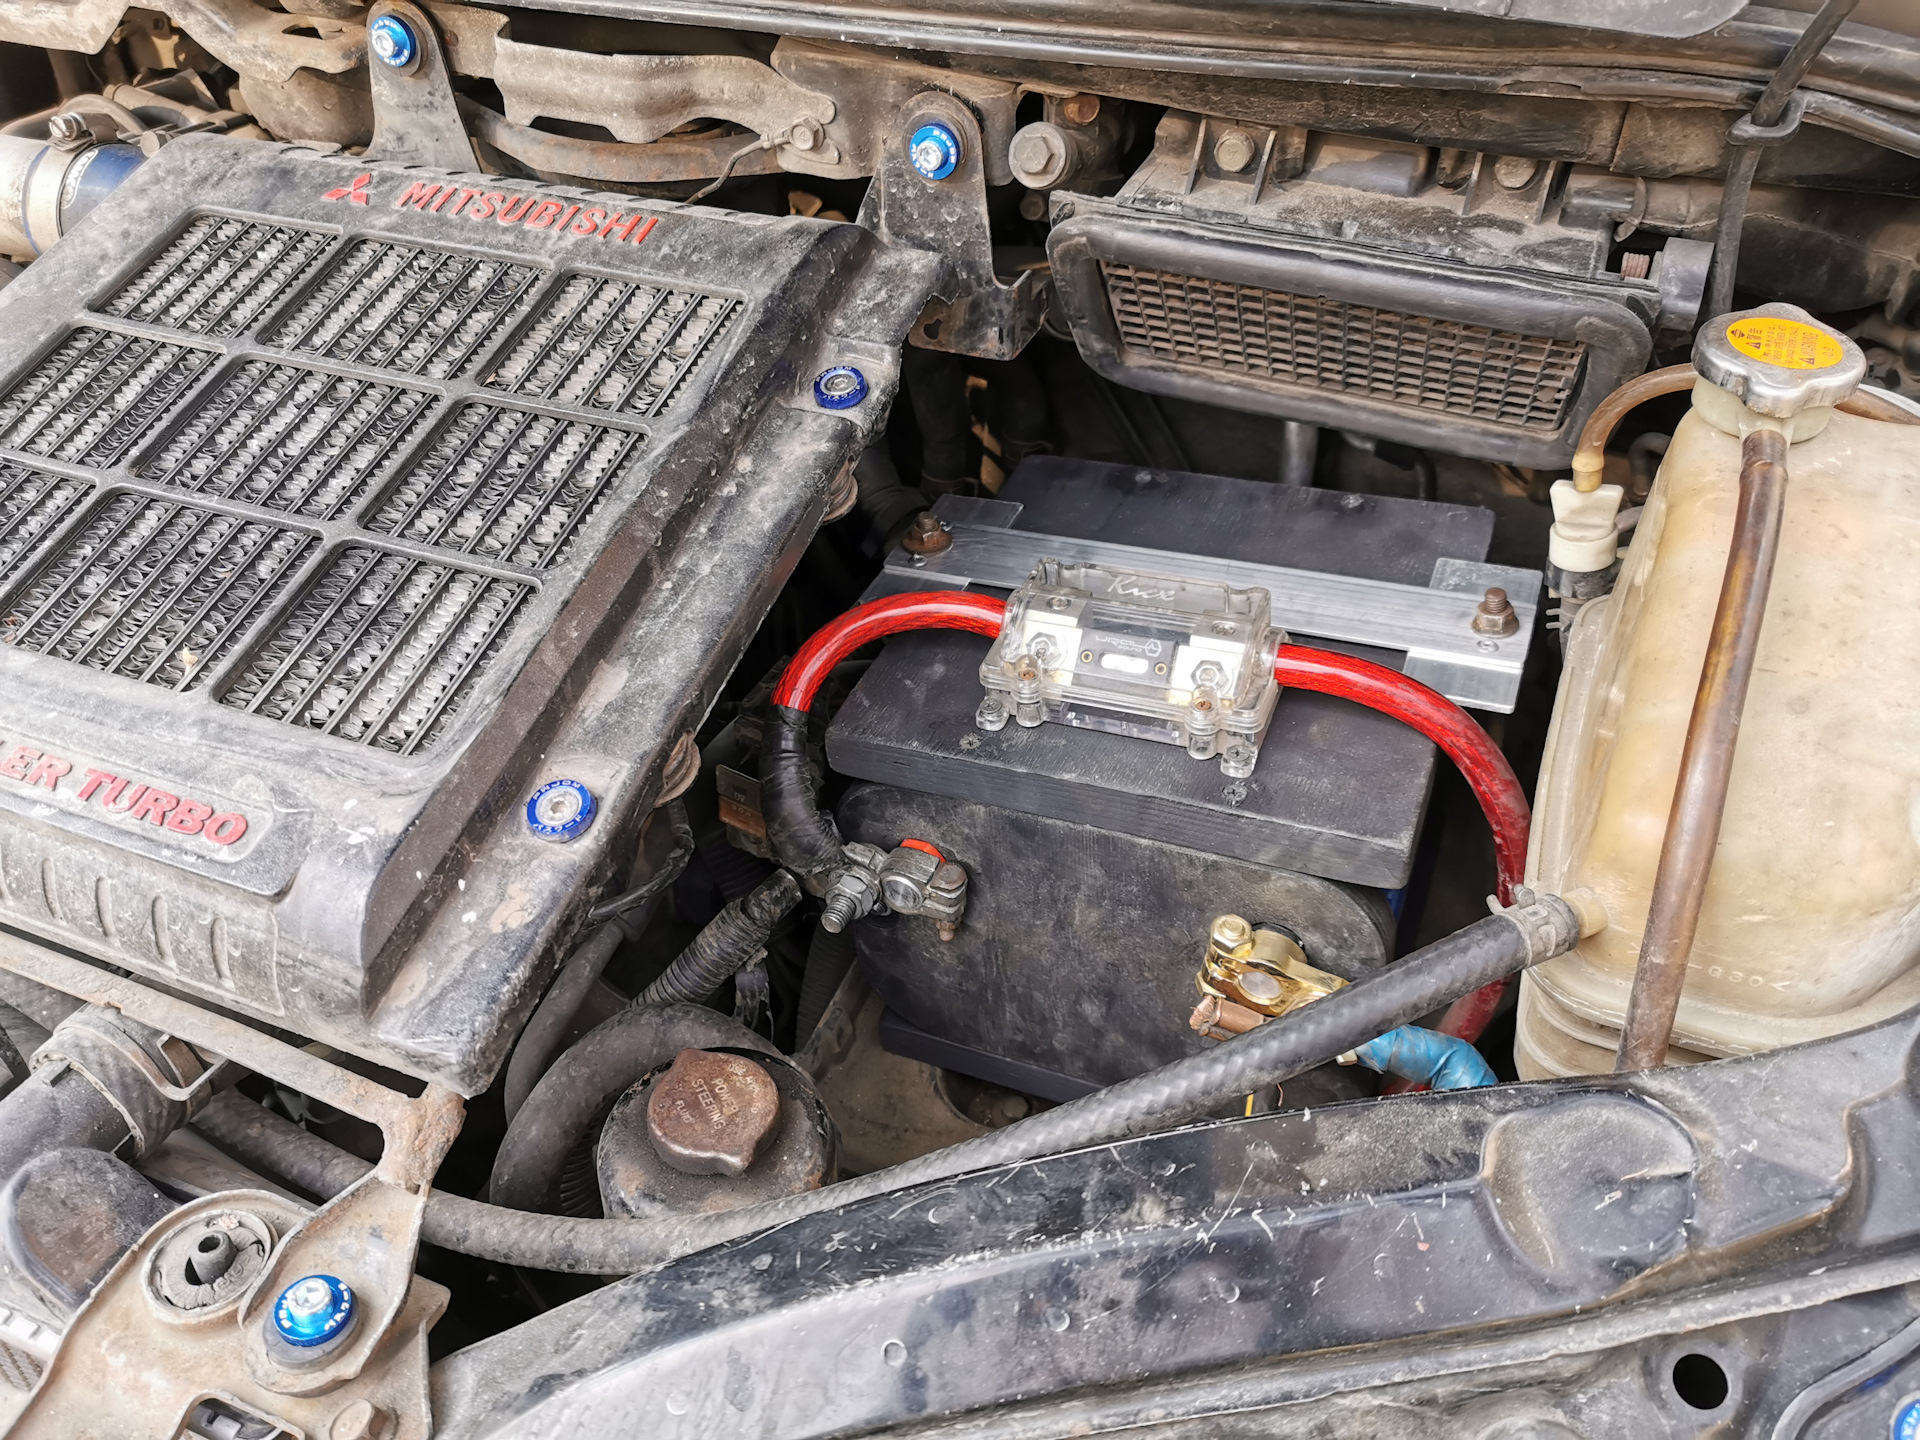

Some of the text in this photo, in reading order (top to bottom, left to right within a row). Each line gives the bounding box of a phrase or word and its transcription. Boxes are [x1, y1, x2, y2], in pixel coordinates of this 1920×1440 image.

[395, 181, 659, 244] MITSUBISHI
[1107, 576, 1175, 601] Kicx
[76, 767, 249, 846] TURBO
[691, 1077, 727, 1131] STEERING
[711, 1077, 740, 1114] POWER
